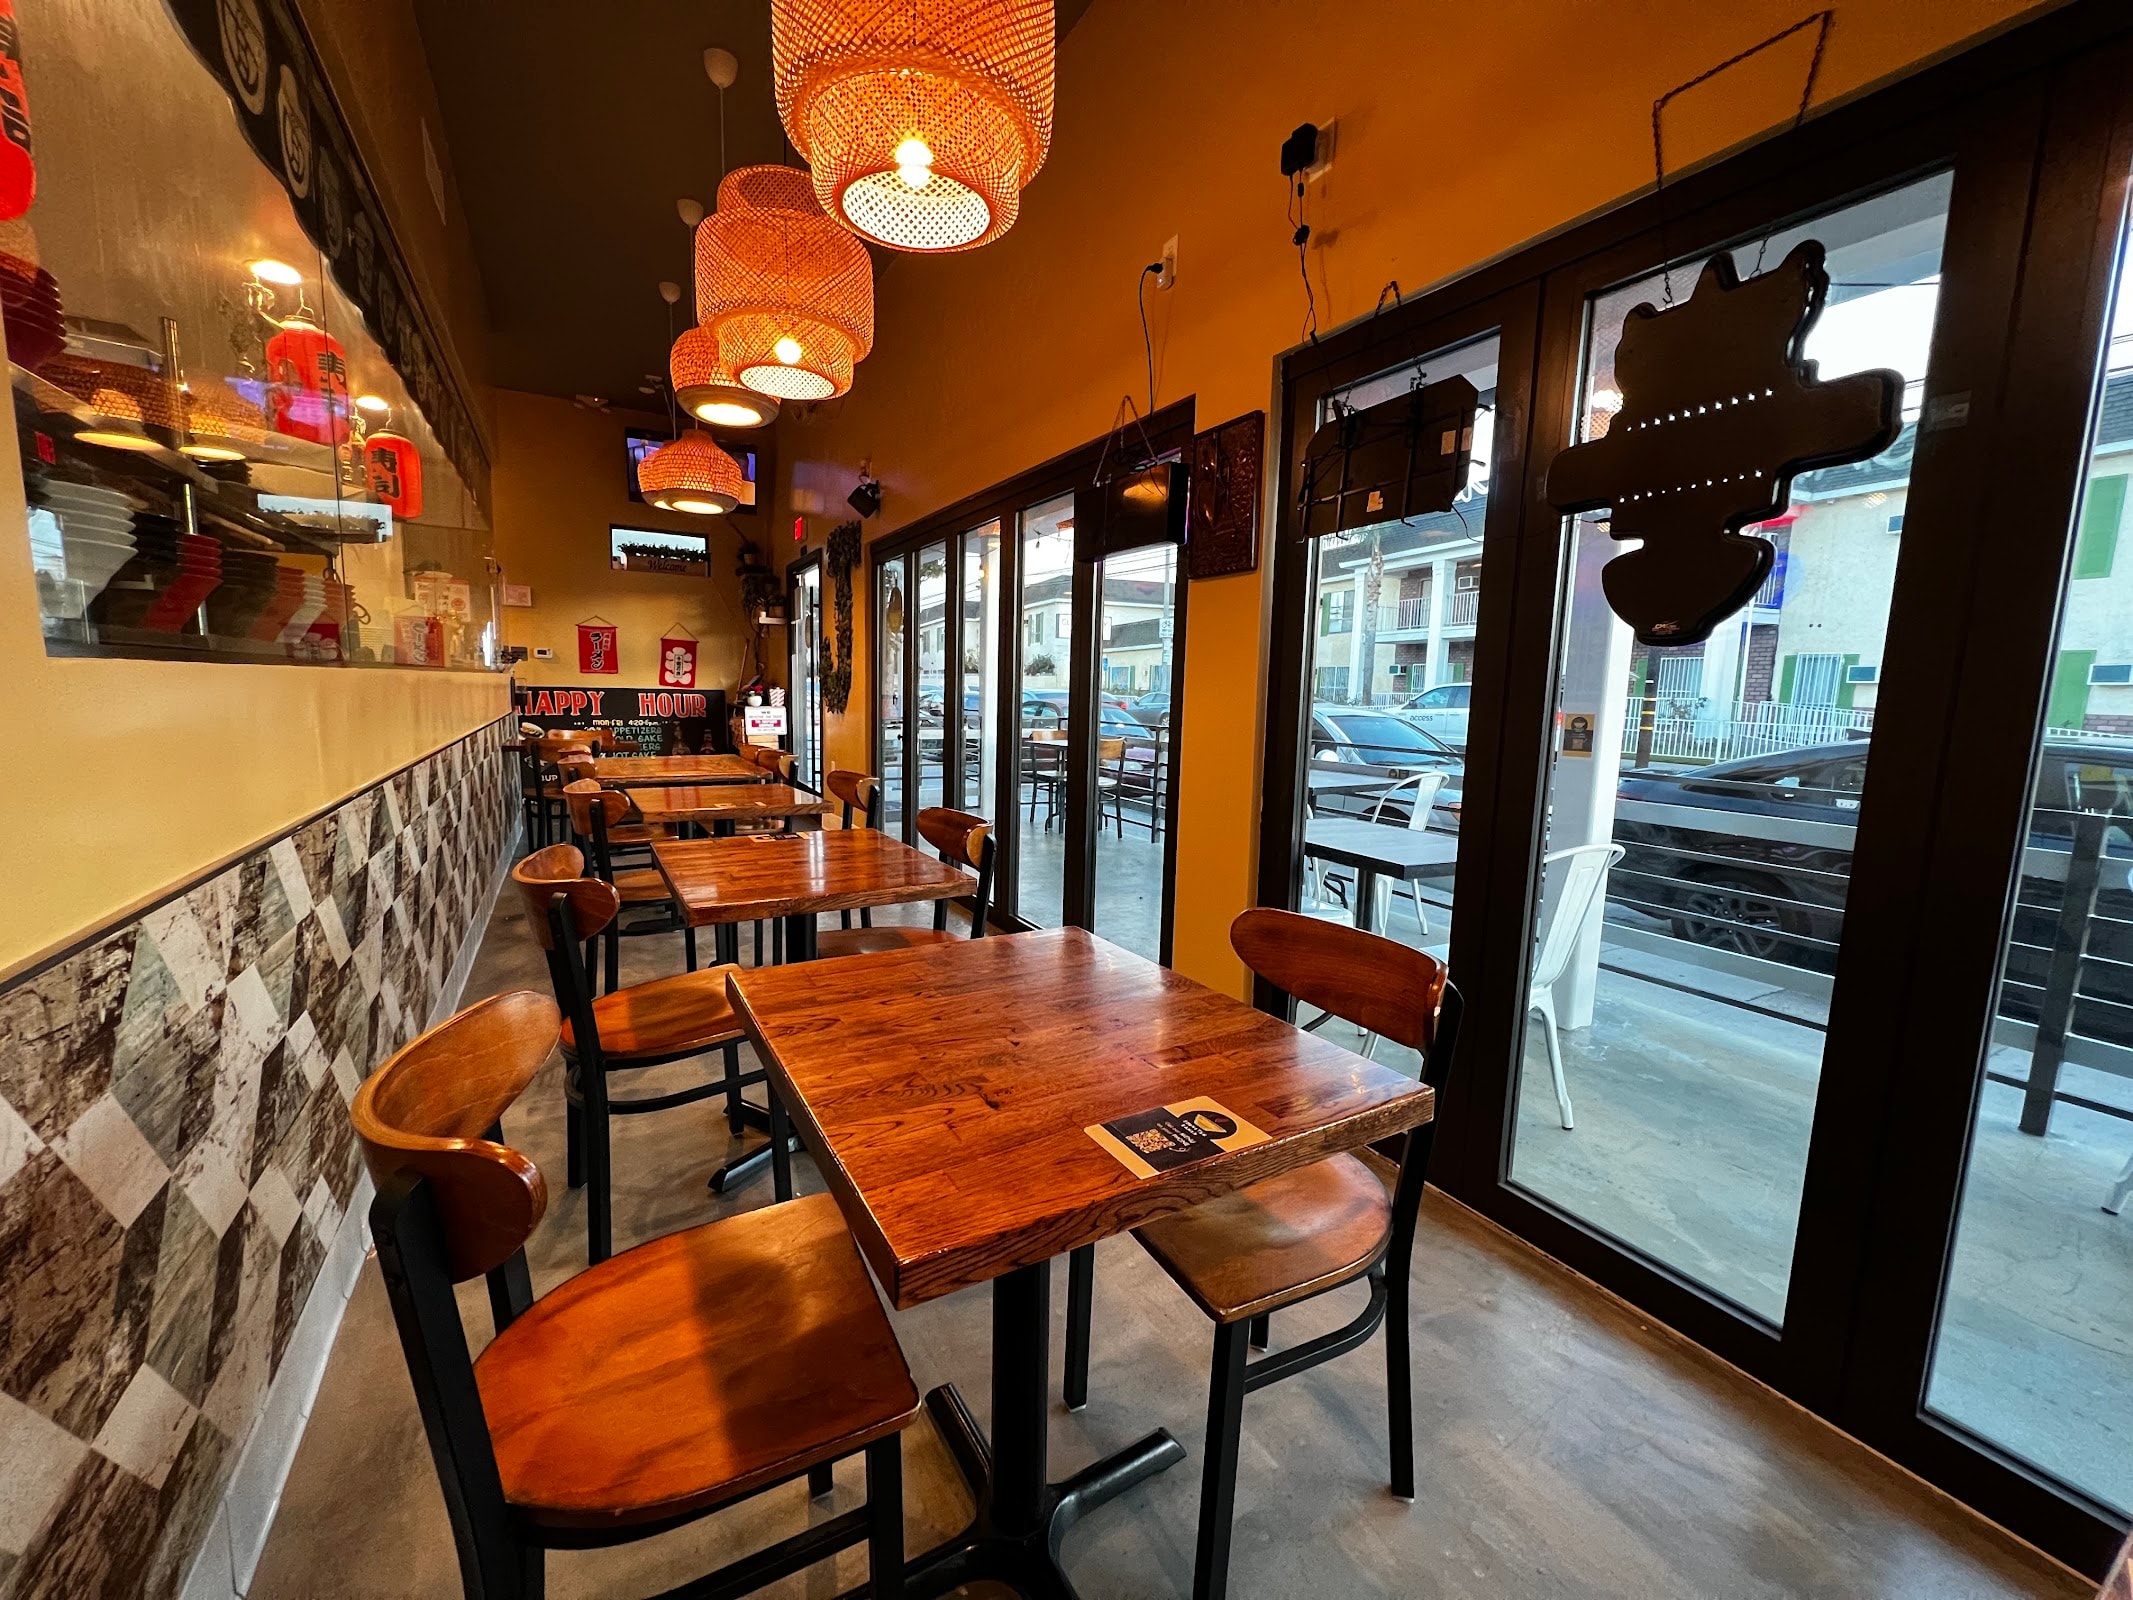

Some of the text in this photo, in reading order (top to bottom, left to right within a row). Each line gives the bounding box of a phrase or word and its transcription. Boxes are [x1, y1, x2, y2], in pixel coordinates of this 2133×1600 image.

[371, 448, 400, 499] 寿司
[647, 559, 688, 572] Welcome
[590, 631, 604, 670] ラーメン
[638, 692, 707, 718] HOUR
[613, 726, 662, 735] PPETIZERS
